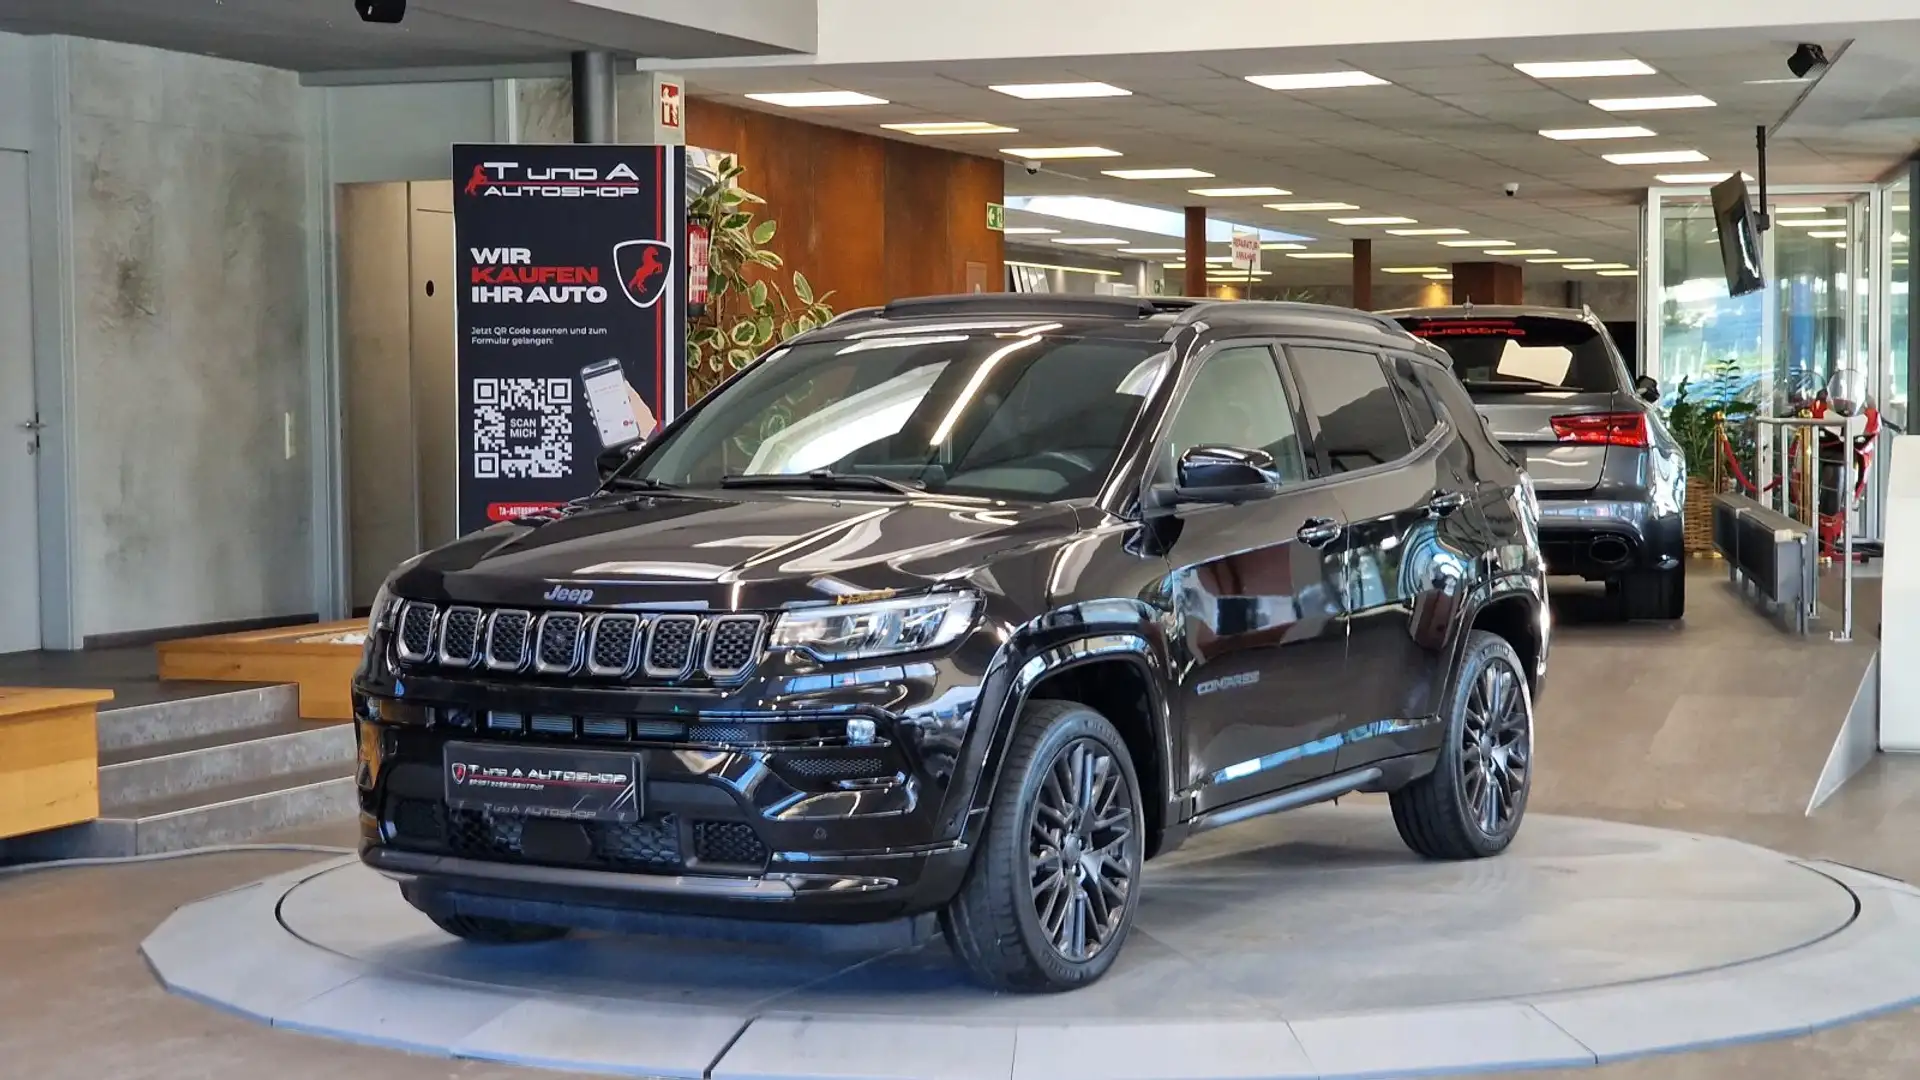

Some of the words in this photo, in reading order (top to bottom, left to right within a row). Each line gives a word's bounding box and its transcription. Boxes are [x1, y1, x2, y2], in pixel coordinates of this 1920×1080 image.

[483, 162, 519, 180] T
[604, 163, 640, 181] A
[483, 186, 640, 197] AUTOSHOP
[470, 247, 531, 265] WIR
[471, 266, 599, 284] KAUFEN
[471, 286, 524, 303] IHR
[526, 286, 608, 304] AUTO
[471, 327, 492, 336] Jetzt
[493, 327, 508, 337] QR
[509, 326, 531, 336] Code
[532, 328, 568, 336] scannen
[570, 326, 586, 336] und
[588, 328, 607, 336] zum
[471, 336, 510, 345] Formular
[512, 336, 553, 347] gelangen:
[510, 418, 537, 428] SCAN
[510, 428, 537, 438] MICH
[543, 584, 594, 605] Jeep
[466, 764, 480, 776] T
[511, 767, 524, 778] A
[528, 769, 628, 784] AUTOSHOP
